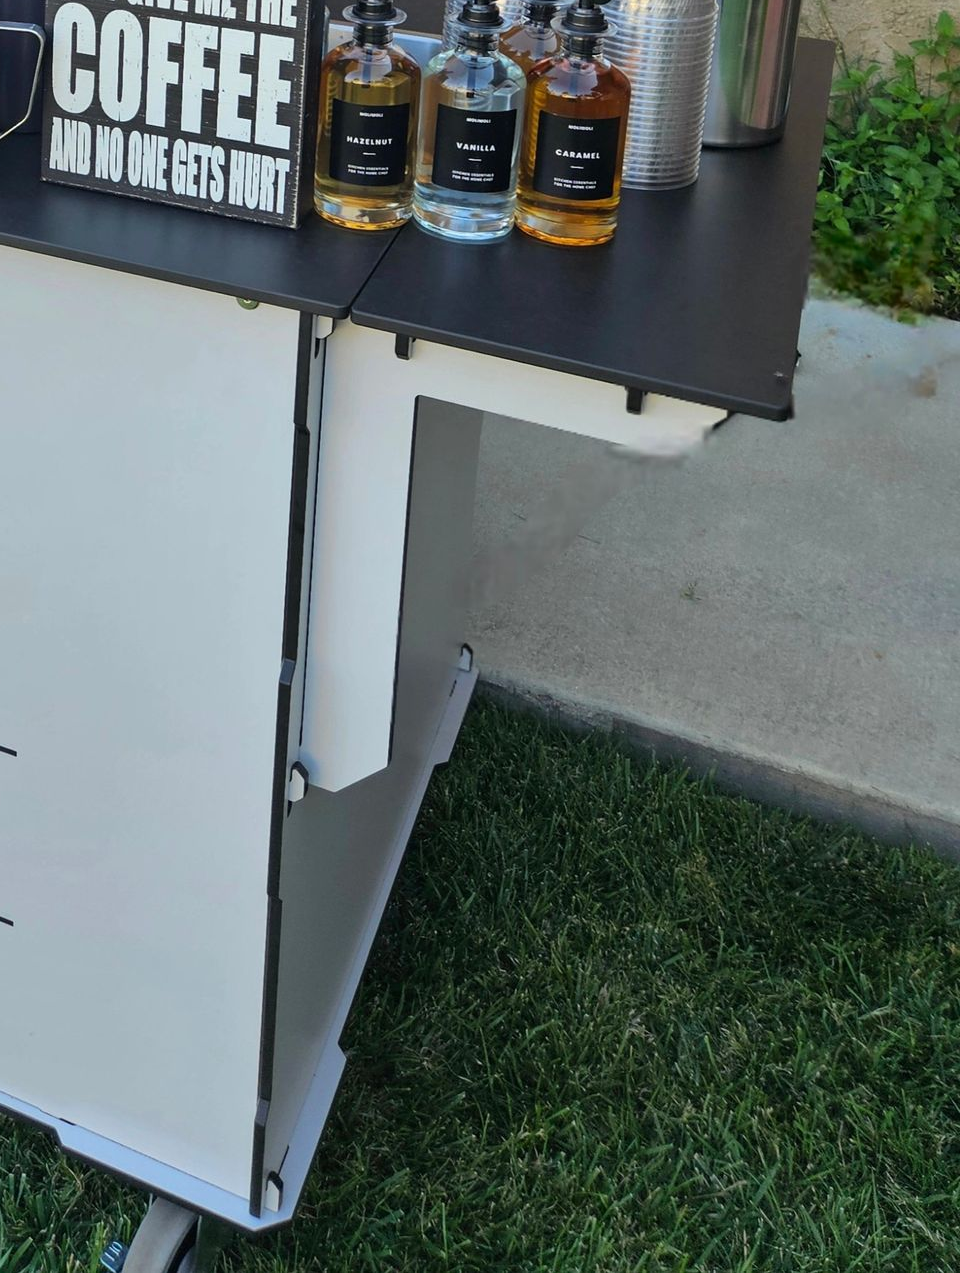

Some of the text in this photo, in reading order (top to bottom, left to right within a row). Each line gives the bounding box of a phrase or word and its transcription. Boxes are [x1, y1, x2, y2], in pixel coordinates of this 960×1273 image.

[52, 2, 295, 150] COFFEE
[346, 135, 393, 145] HAZELNUT
[456, 141, 496, 152] VANILLA
[555, 149, 600, 159] CARAMEL
[49, 116, 290, 214] AND NO ONE GETS HURT
